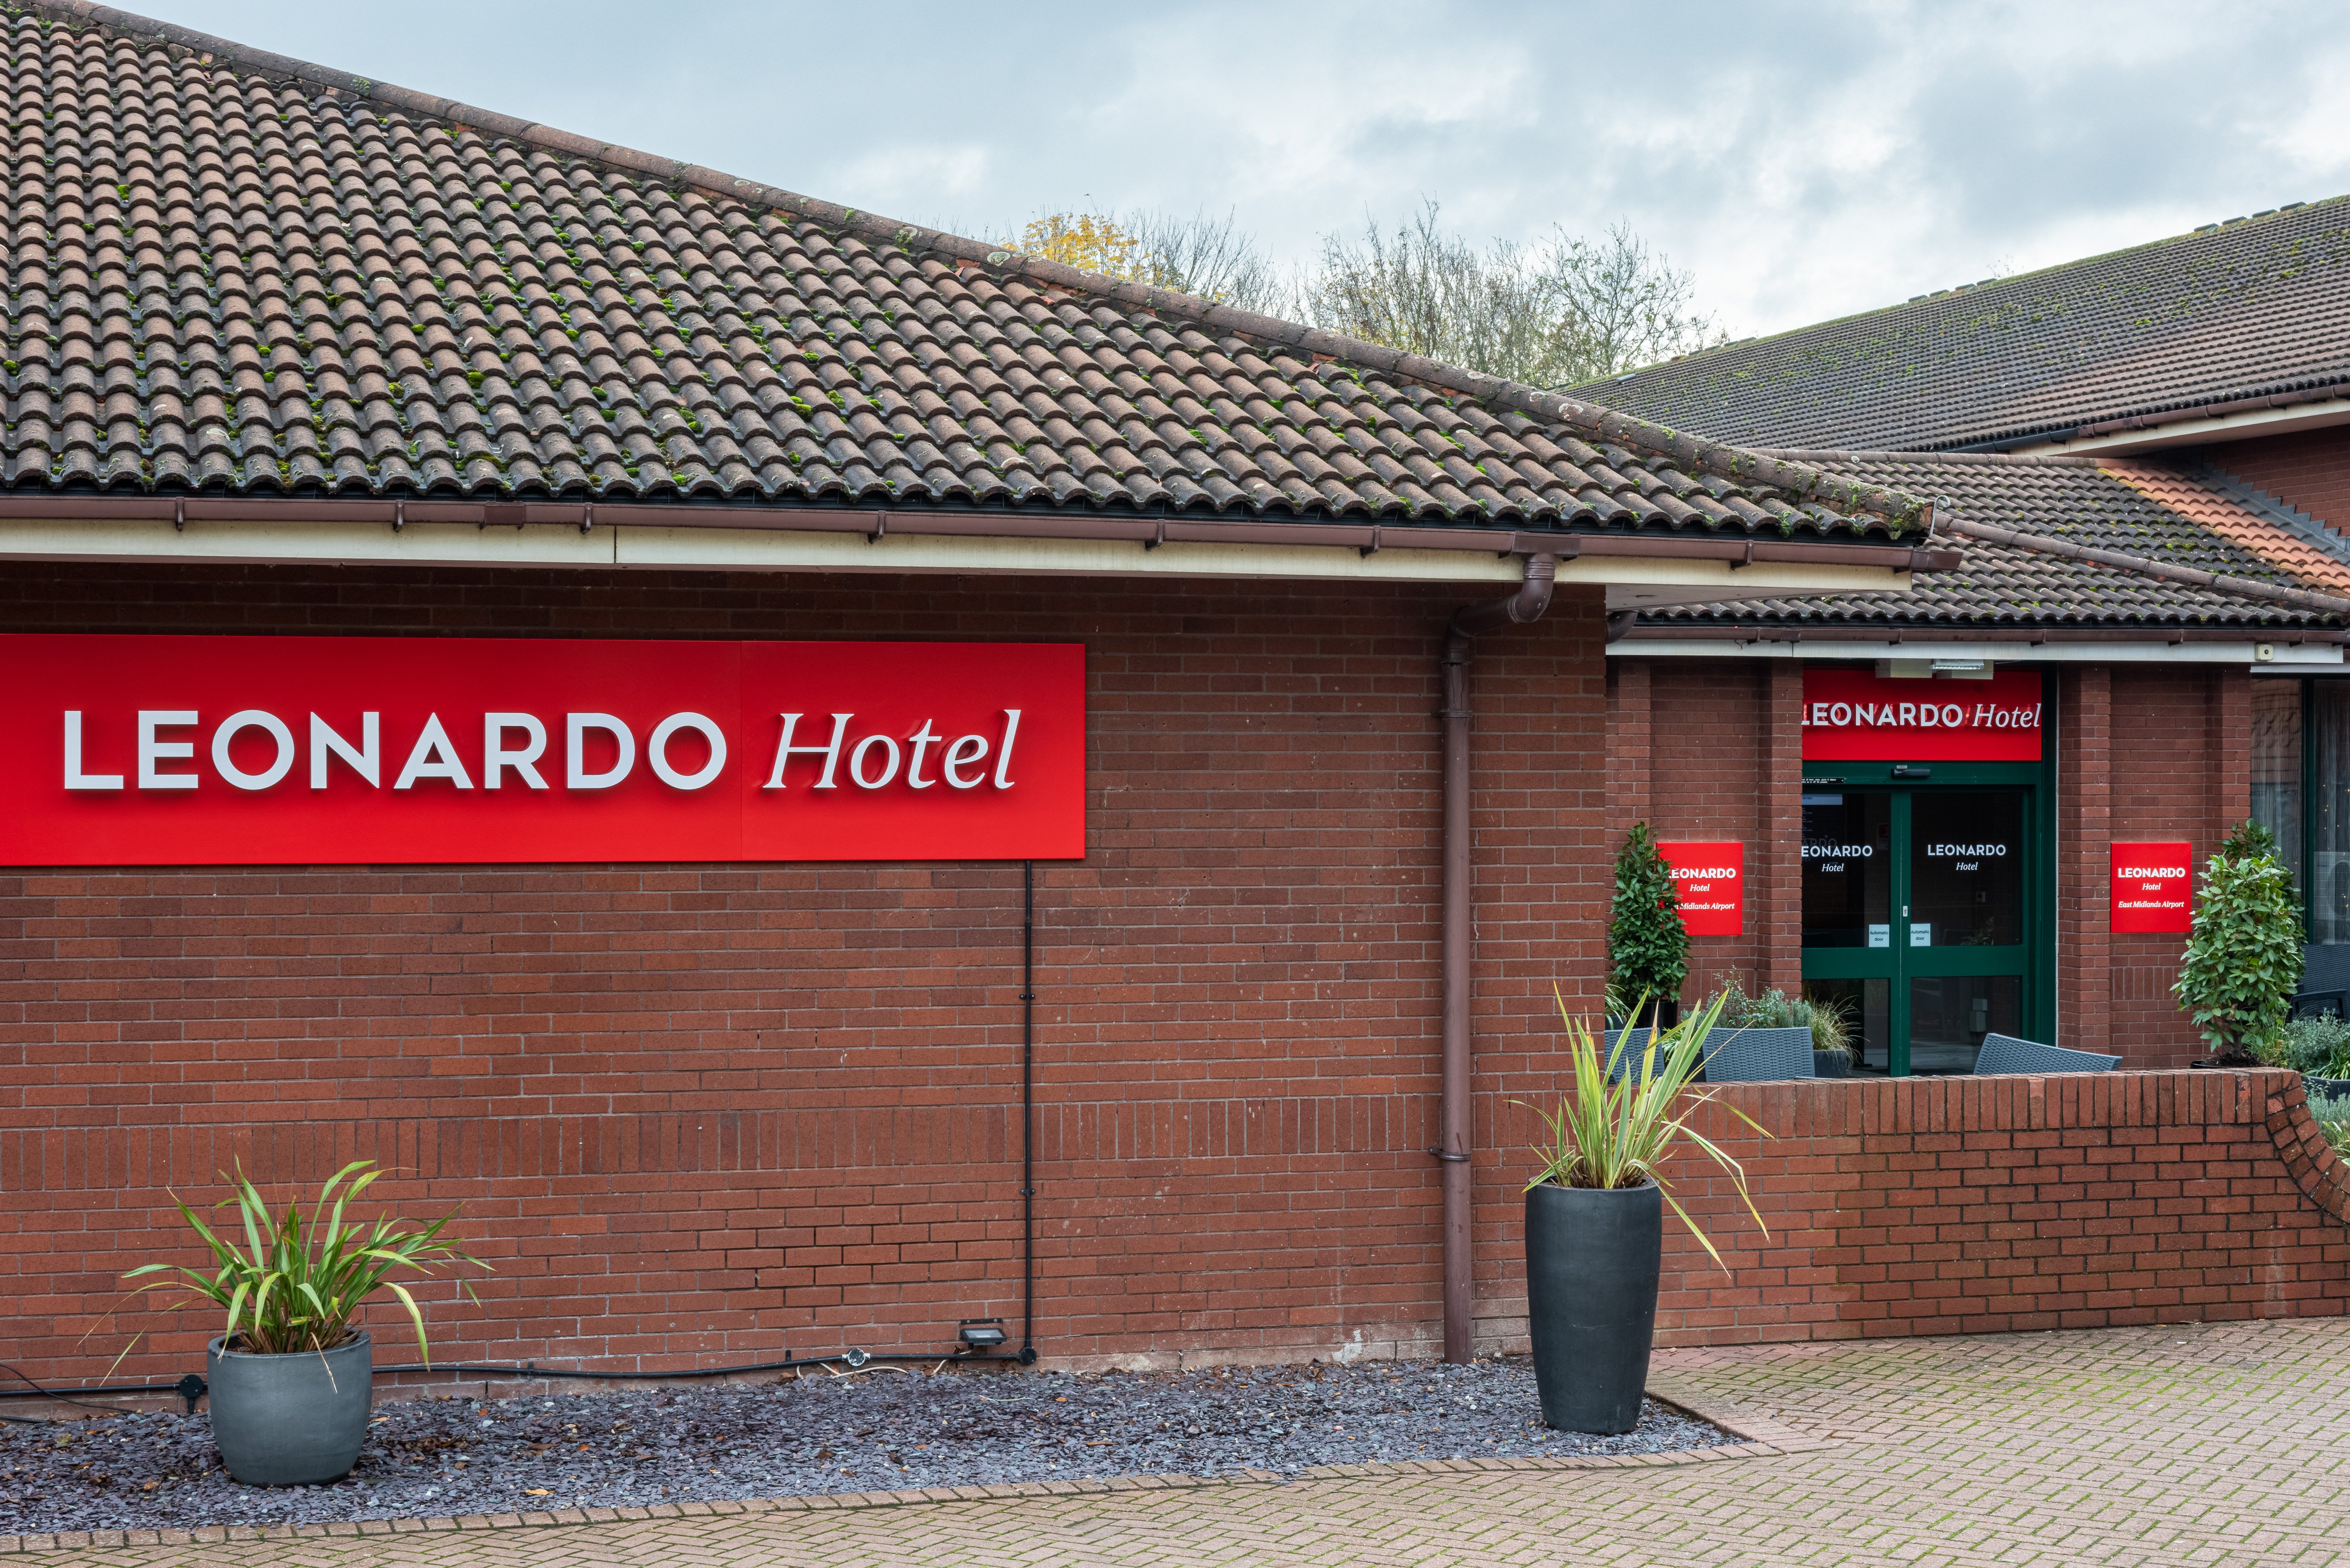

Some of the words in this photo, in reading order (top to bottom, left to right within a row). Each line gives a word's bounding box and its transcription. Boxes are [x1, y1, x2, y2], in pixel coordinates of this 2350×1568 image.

[1971, 703, 2041, 728] Hotel
[63, 709, 728, 791] LEONARDO
[762, 709, 1022, 790] Hotel
[1801, 845, 1872, 857] EONARDO
[1927, 844, 2006, 856] LEONARDO
[1821, 863, 1844, 872] Hotel
[1956, 862, 1978, 870] Hotel
[1668, 868, 1736, 879] EONARDO
[2118, 867, 2186, 878] LEONARDO
[1689, 883, 1710, 892] Hotel
[1710, 902, 1735, 911] Airport
